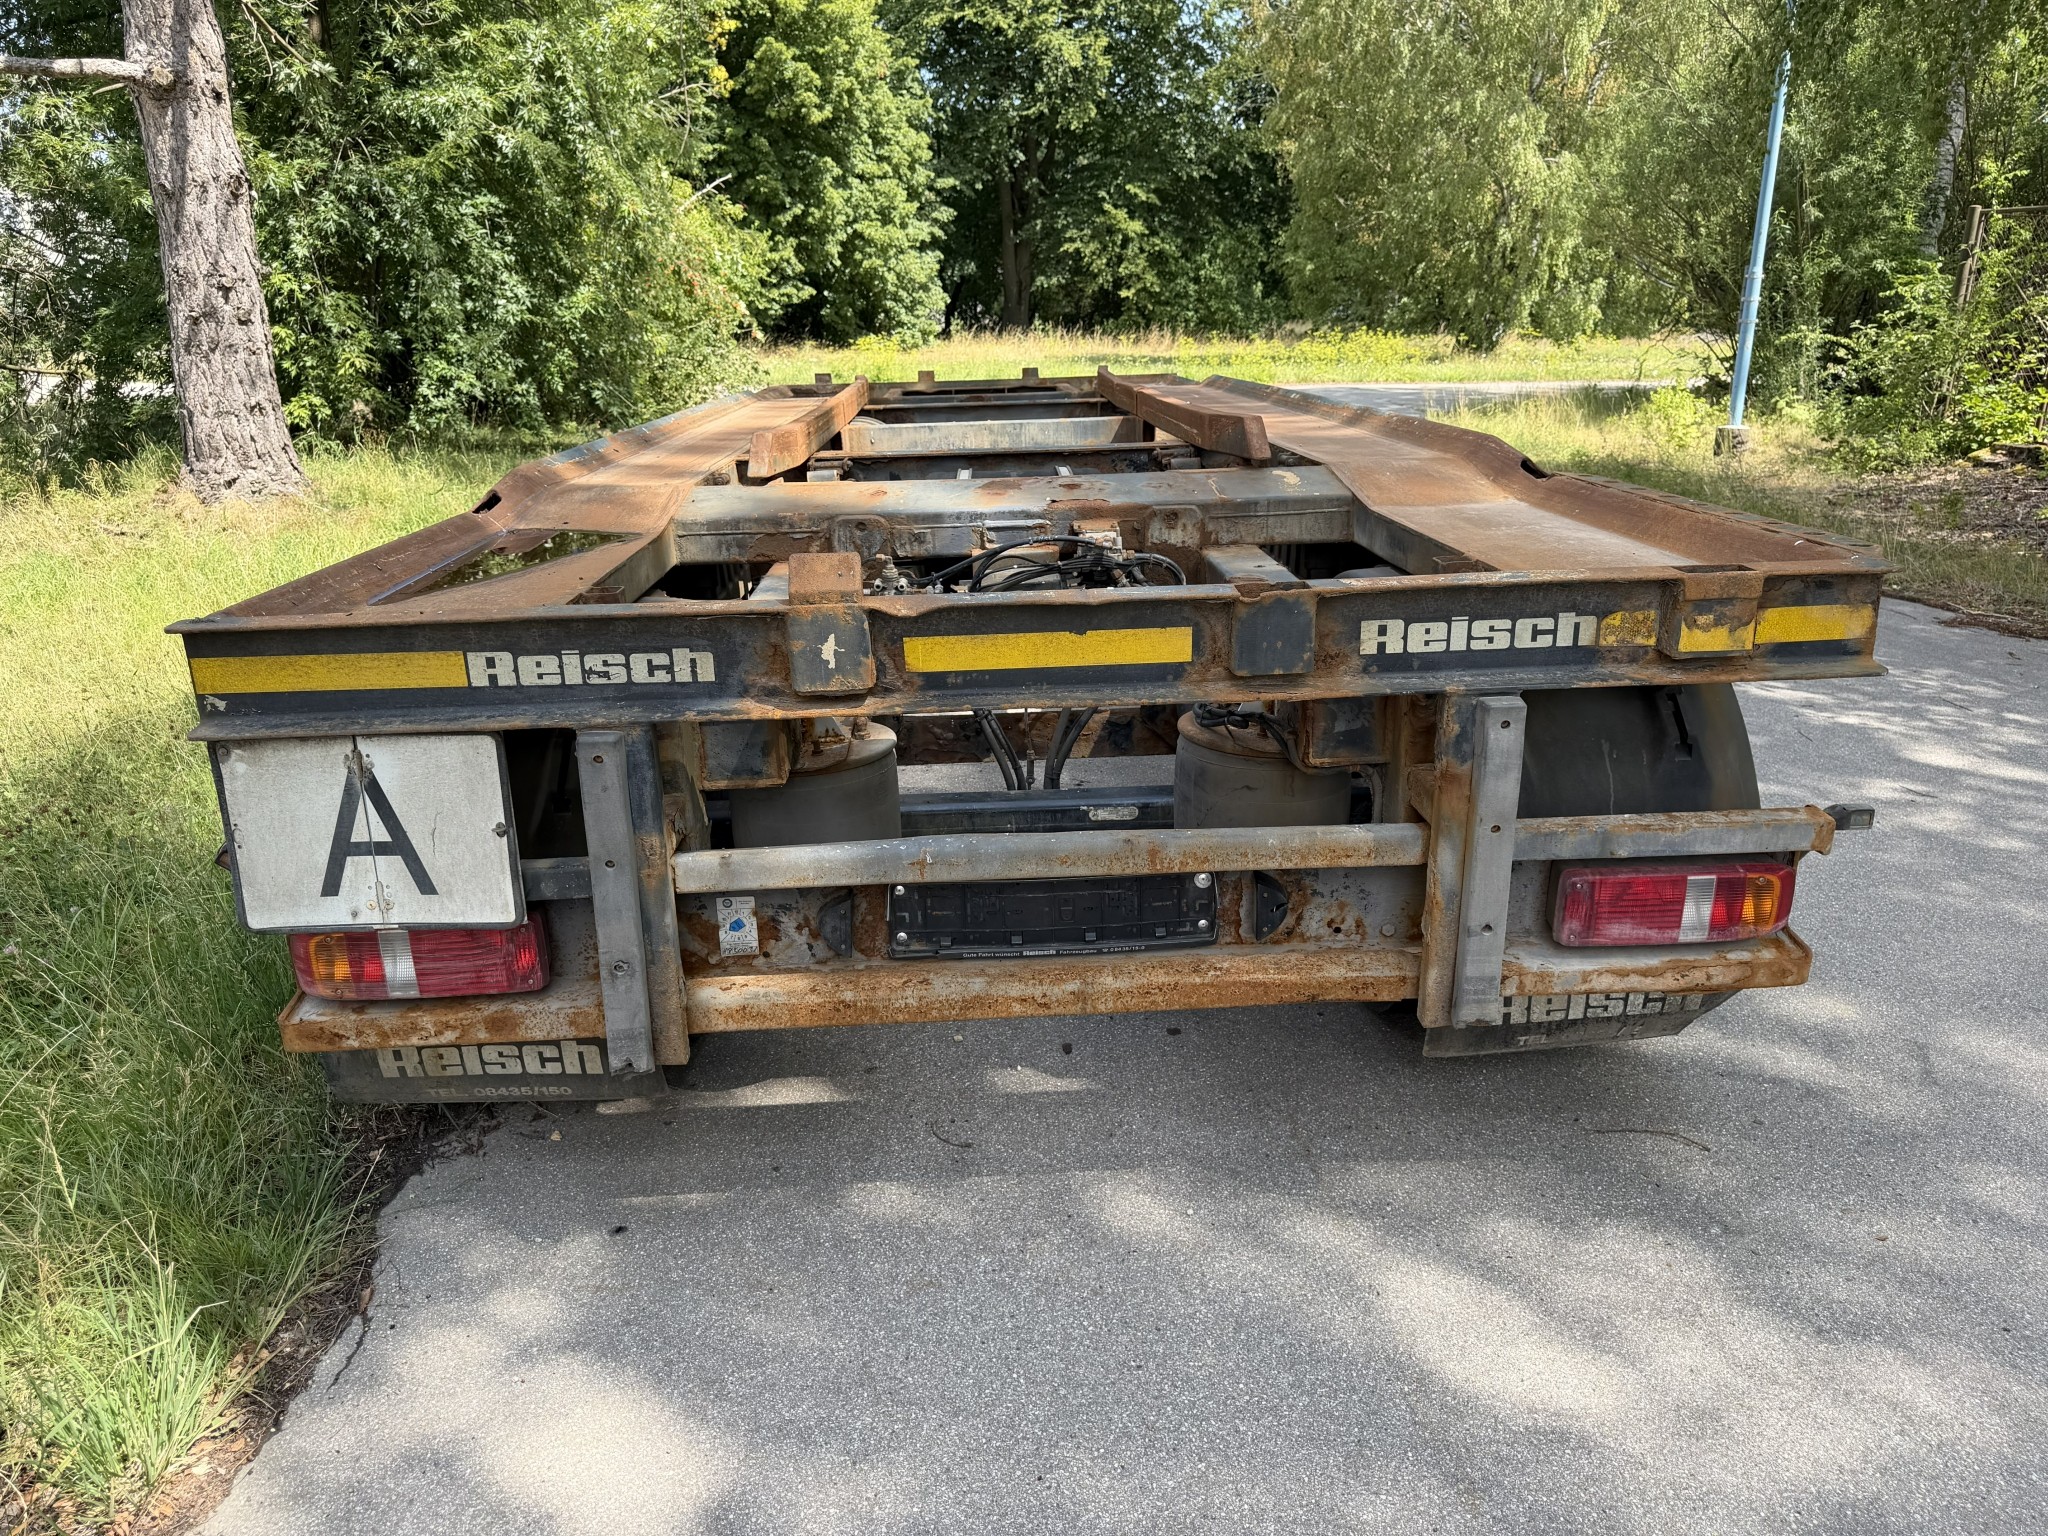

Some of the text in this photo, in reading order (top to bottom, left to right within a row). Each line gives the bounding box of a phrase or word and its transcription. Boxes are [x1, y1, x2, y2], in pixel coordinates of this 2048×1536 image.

[1359, 612, 1598, 654] Reisch
[466, 648, 716, 687] Reisch
[320, 768, 439, 897] A
[377, 1041, 604, 1078] Reisch
[474, 1086, 573, 1097] 08435/150
